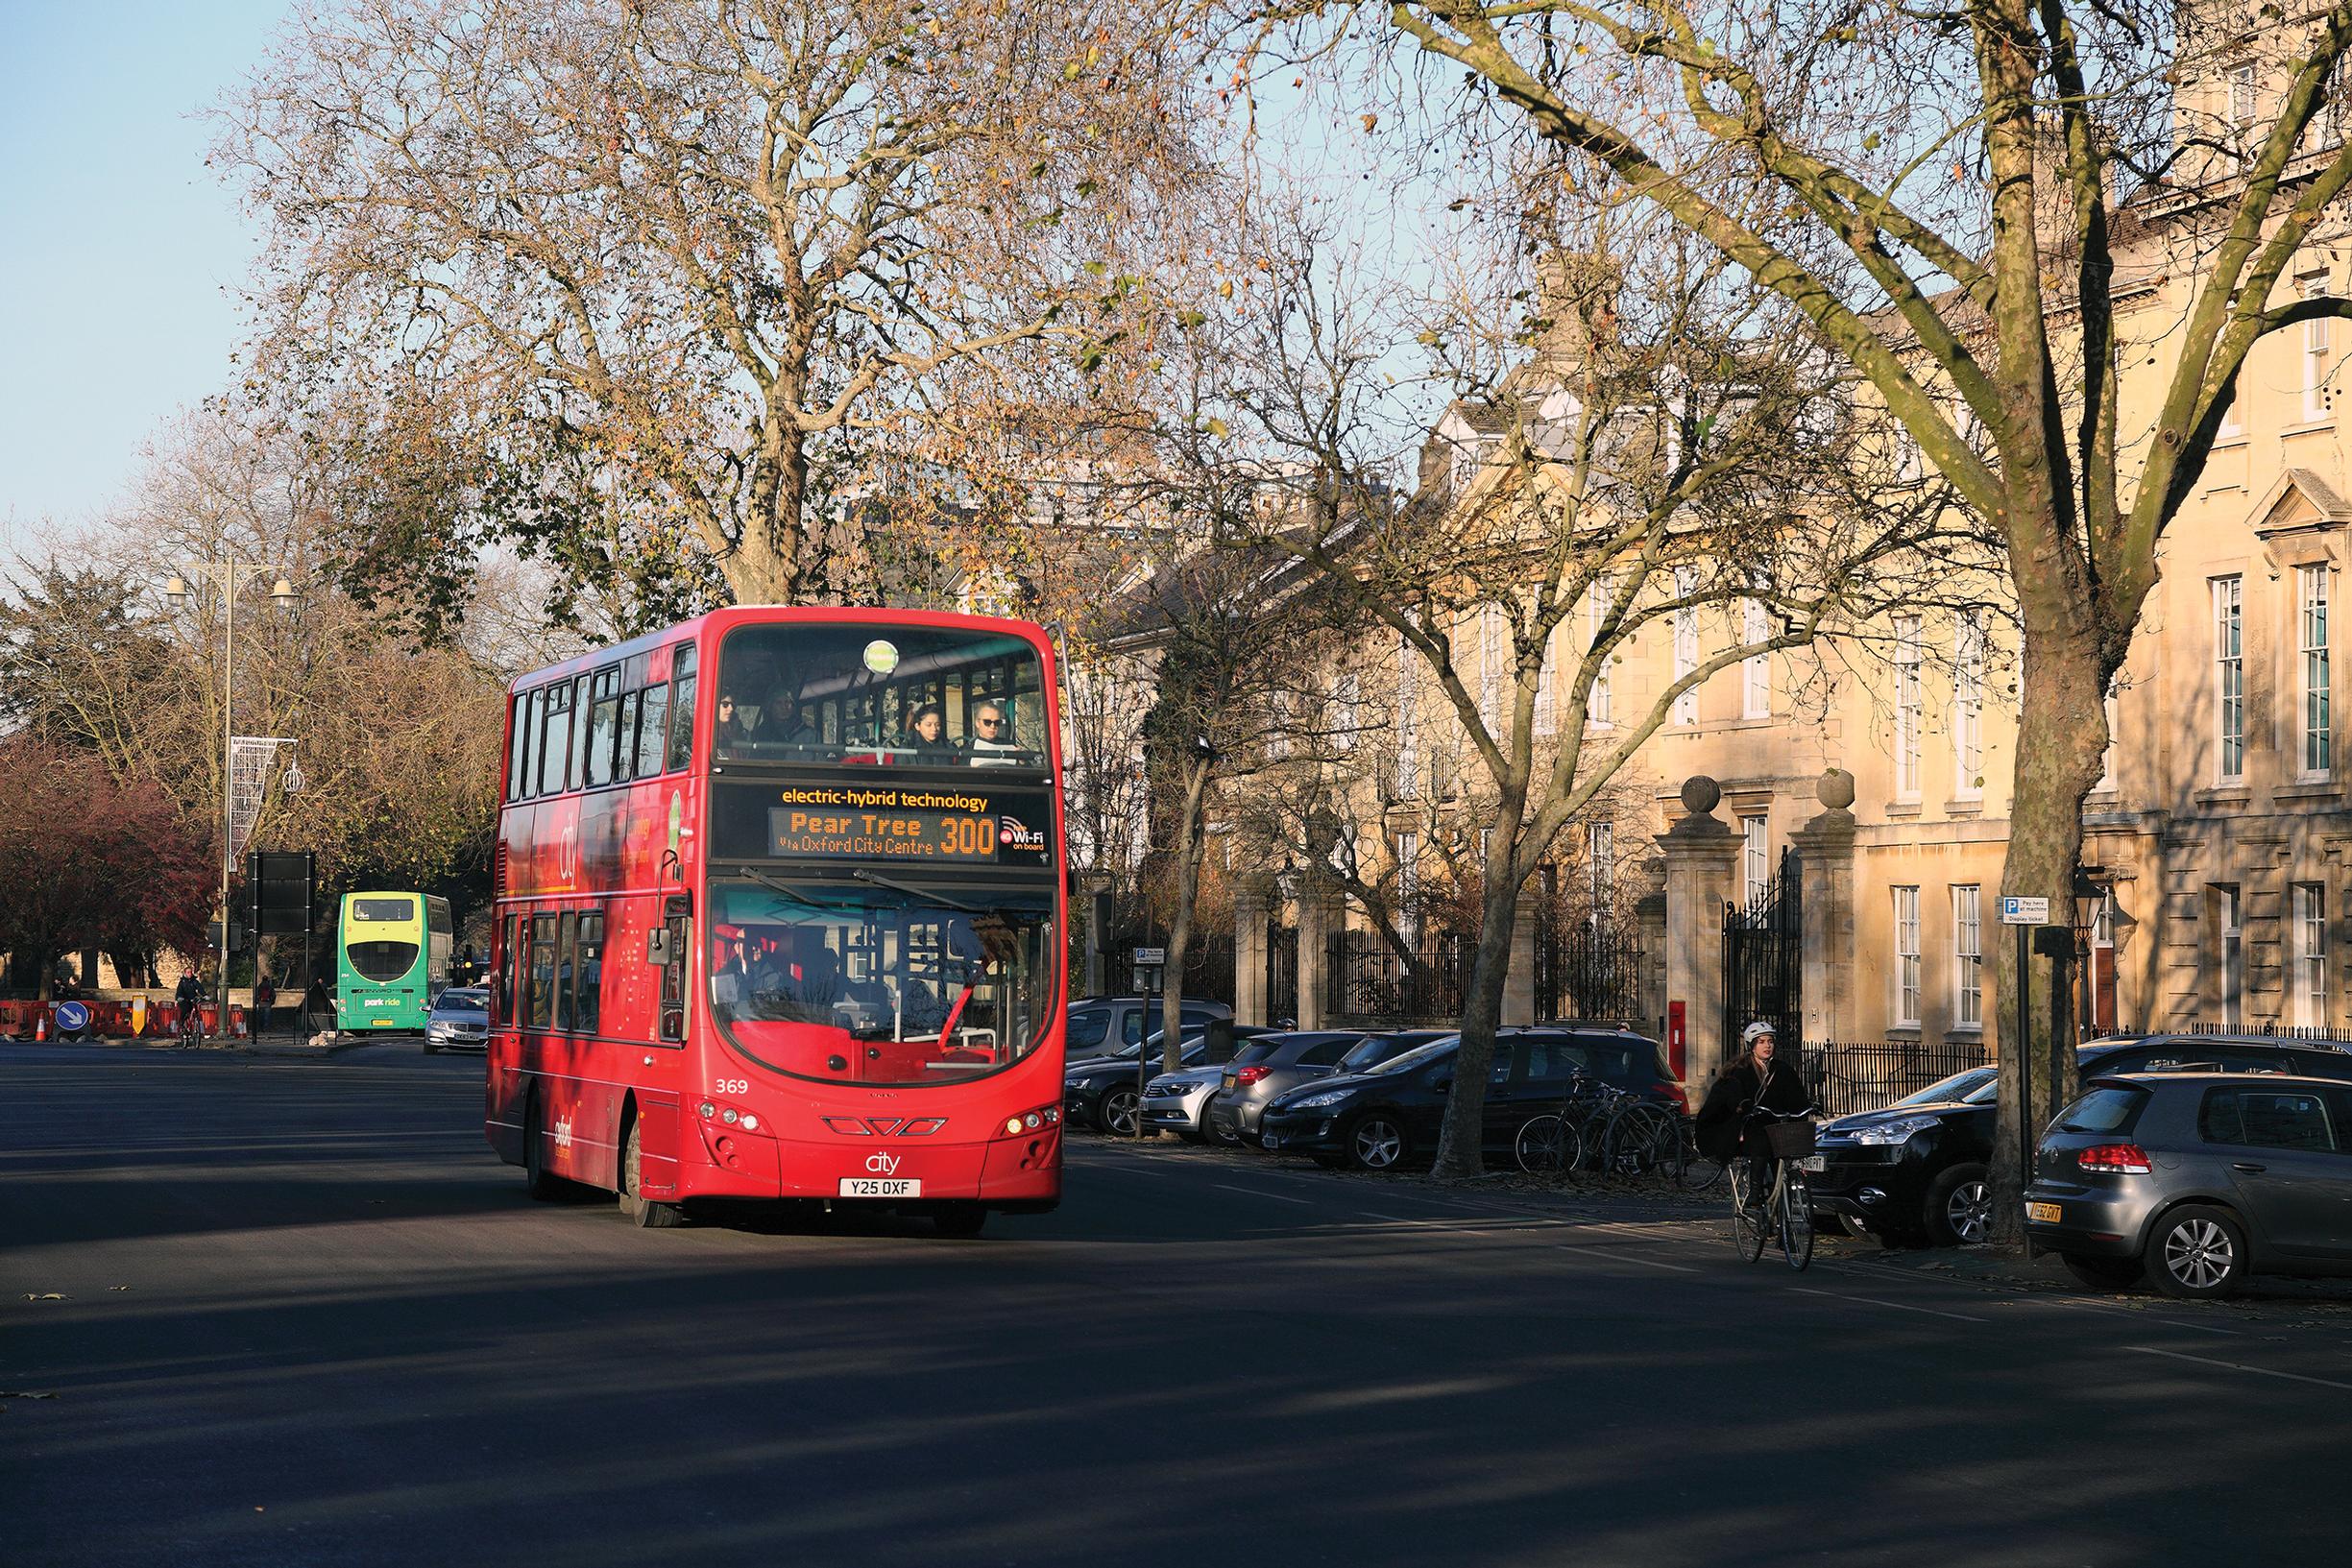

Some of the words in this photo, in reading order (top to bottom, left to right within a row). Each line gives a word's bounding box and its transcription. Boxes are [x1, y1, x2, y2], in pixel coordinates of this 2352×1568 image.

[782, 788, 896, 808] electric-hybrid
[901, 792, 987, 812] technology
[791, 812, 852, 833] Pear
[861, 815, 921, 835] Tree
[802, 835, 852, 852] Oxford
[855, 837, 883, 854] City
[885, 838, 934, 855] Centre
[940, 817, 994, 855] 300
[1013, 832, 1043, 843] Wi-Fi
[2007, 900, 2017, 913] P
[364, 999, 384, 1008] park
[715, 1078, 748, 1094] 369
[865, 1151, 901, 1176] city
[851, 1181, 879, 1194] Y25
[883, 1181, 909, 1194] OXF
